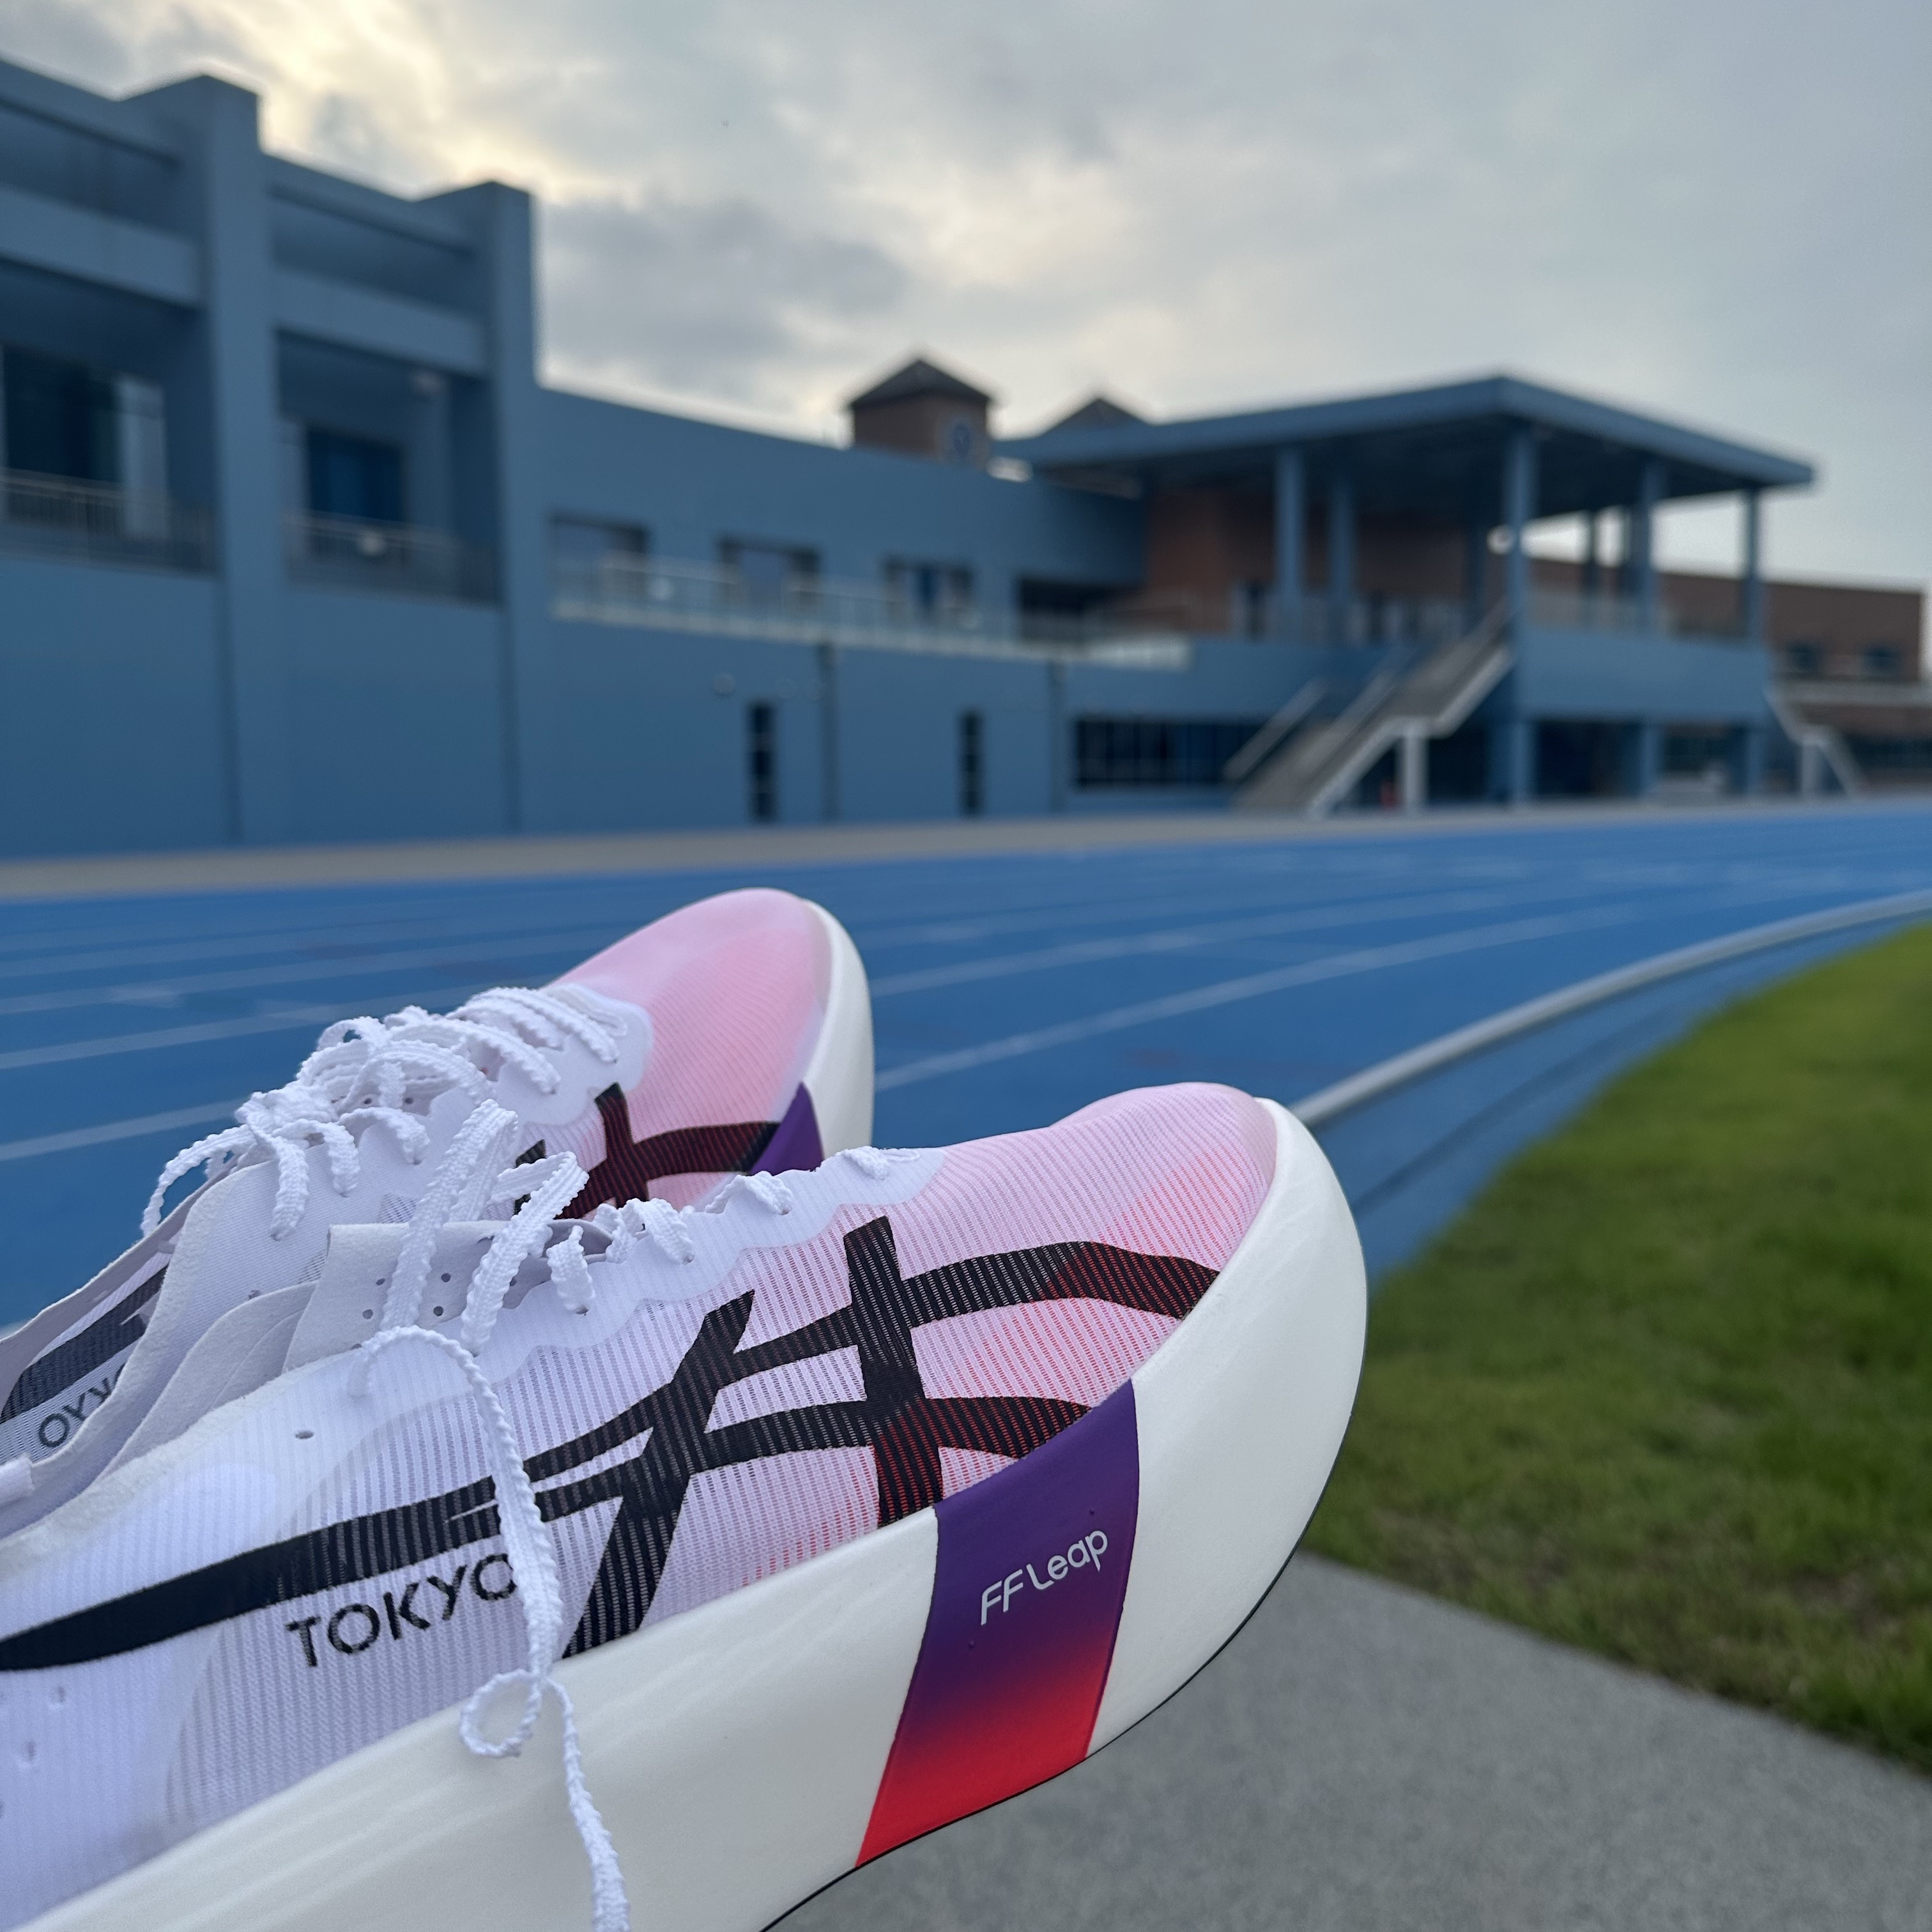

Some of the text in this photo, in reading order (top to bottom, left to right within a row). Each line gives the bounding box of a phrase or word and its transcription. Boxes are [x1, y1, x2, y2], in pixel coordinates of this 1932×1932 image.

[285, 1553, 516, 1667] TOKYO
[981, 1530, 1108, 1626] FF Leap
